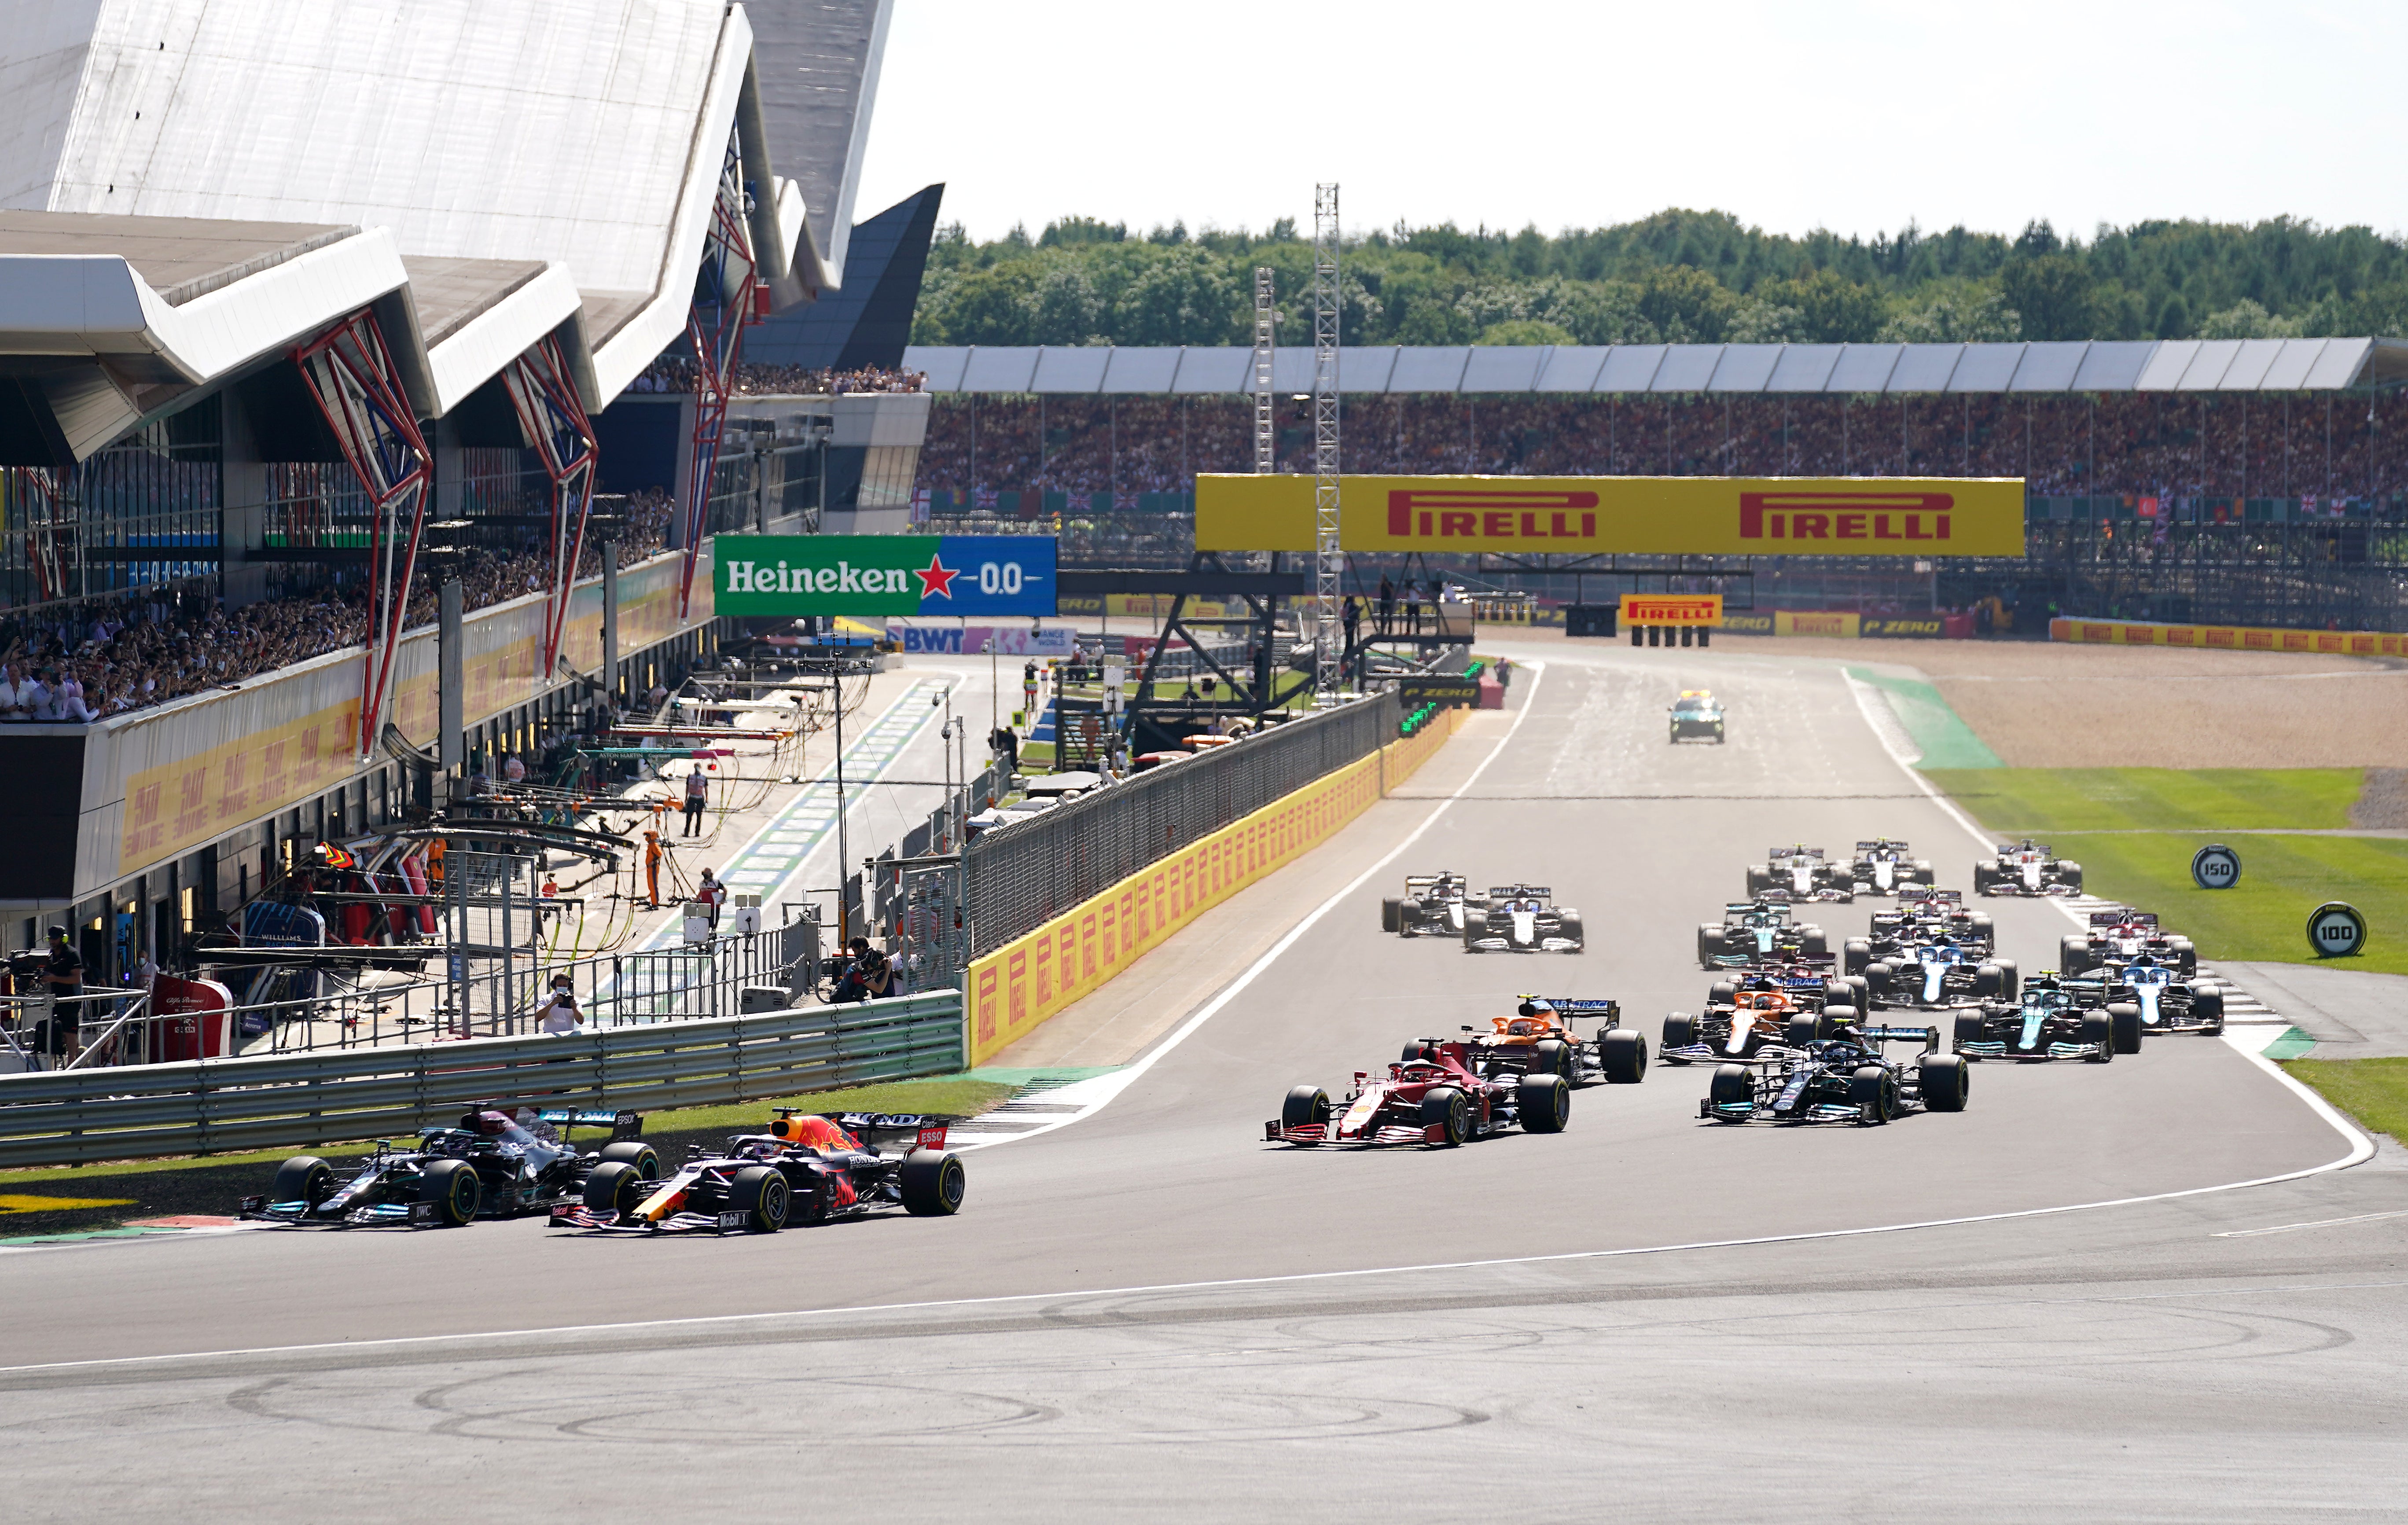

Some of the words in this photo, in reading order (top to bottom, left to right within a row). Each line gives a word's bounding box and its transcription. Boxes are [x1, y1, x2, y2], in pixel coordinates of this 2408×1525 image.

[1389, 490, 1599, 537] PIRELLI
[1741, 492, 1954, 539] PIRELLI
[726, 560, 909, 593] Heineken
[980, 562, 1022, 595] 0.0
[1629, 602, 1715, 619] PIRELLI
[1793, 616, 1842, 633] PIRELLI
[1864, 620, 1881, 633] P
[1883, 621, 1941, 633] ZERO
[904, 628, 964, 651] BWT
[1422, 688, 1477, 697] ZERO
[2205, 863, 2230, 876] 150
[2322, 926, 2353, 940] 100
[978, 966, 997, 1046] PIRELLI
[618, 1114, 635, 1125] EPSON
[922, 1119, 935, 1128] Claro
[921, 1131, 942, 1143] ESSO
[848, 1154, 880, 1165] HONDA
[416, 1205, 432, 1218] IWC
[552, 1205, 569, 1216] telcel
[720, 1213, 739, 1227] Mobil
[741, 1213, 747, 1224] 1
